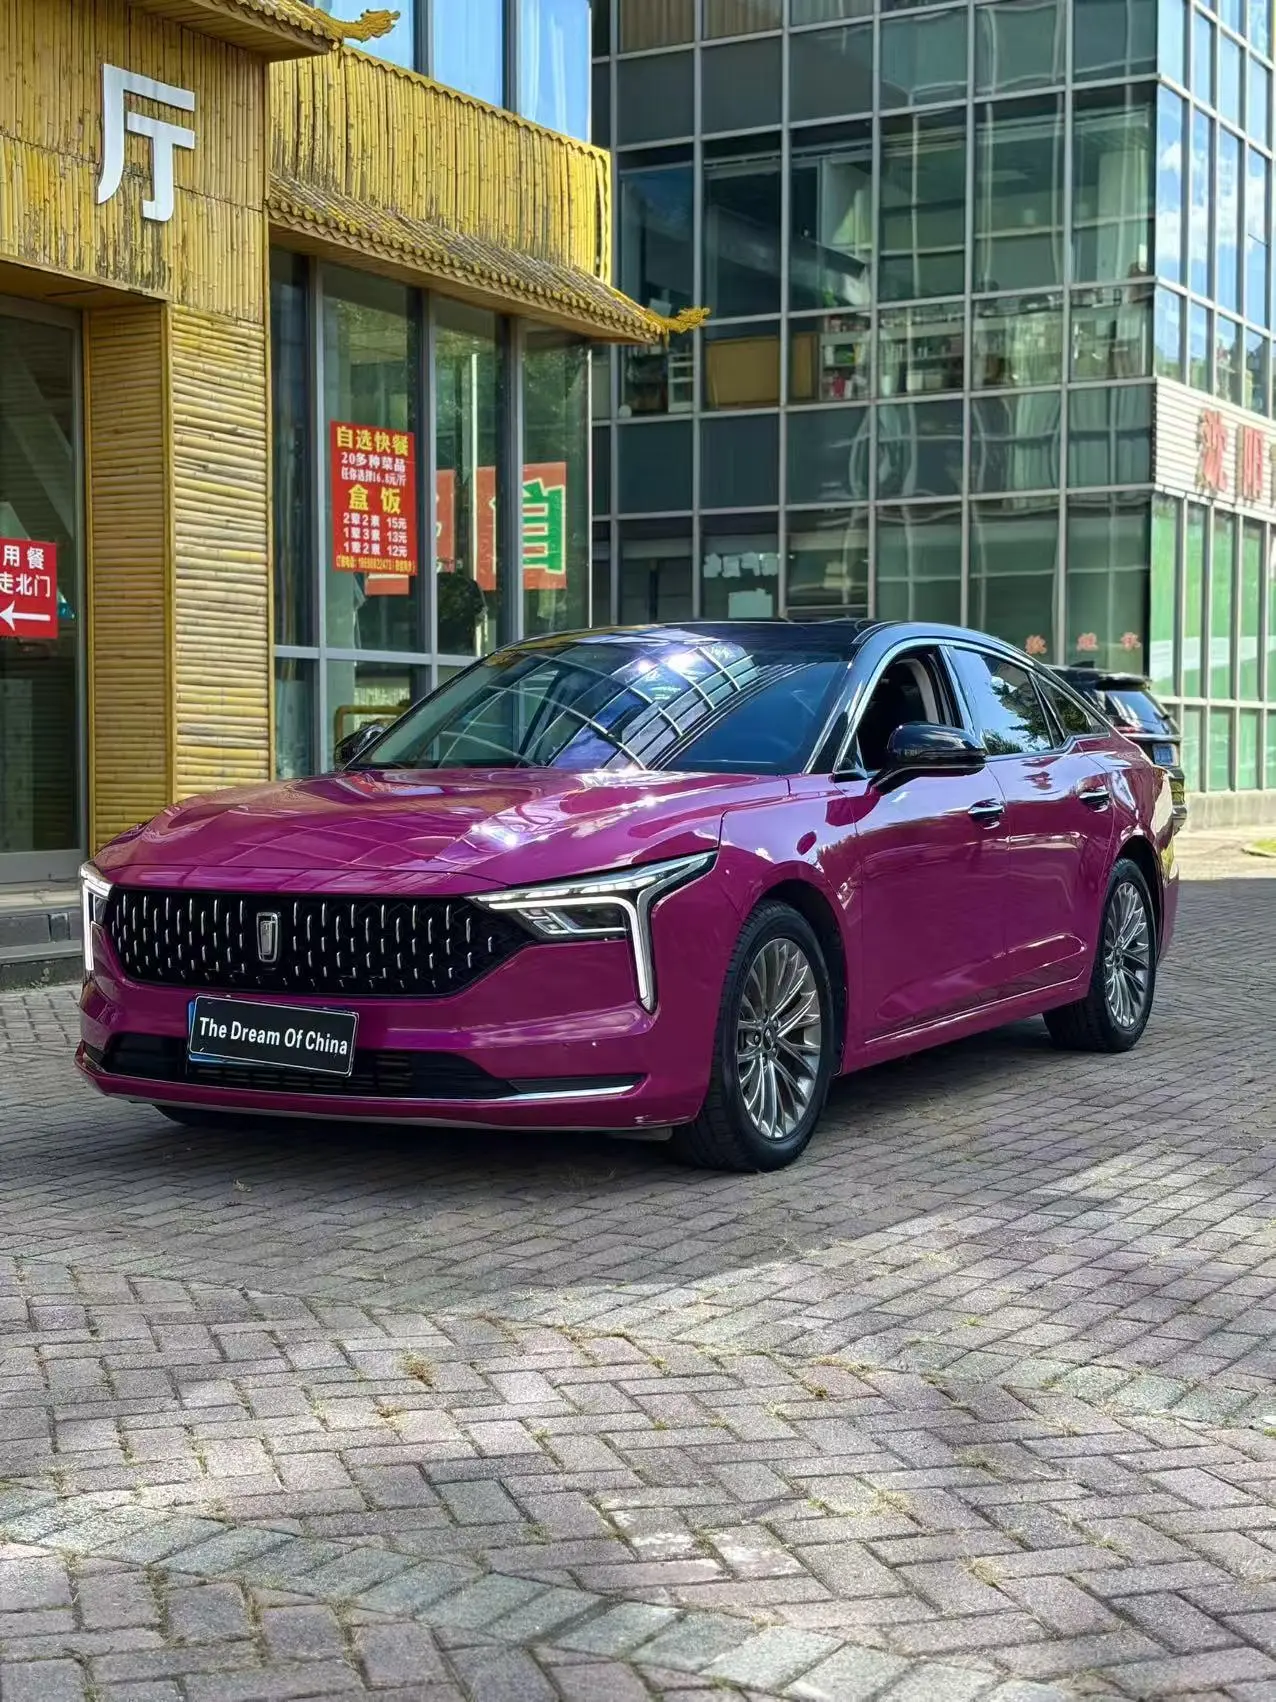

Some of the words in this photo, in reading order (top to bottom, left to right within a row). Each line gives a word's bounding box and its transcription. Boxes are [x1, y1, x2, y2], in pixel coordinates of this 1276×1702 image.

[97, 63, 195, 222] 厅
[336, 426, 409, 456] 自选快餐
[341, 451, 406, 473] 20多种菜品
[3, 545, 45, 570] 用餐
[0, 571, 51, 598] 走北门
[200, 1017, 228, 1039] The
[231, 1021, 281, 1046] Dream
[284, 1028, 303, 1049] Of
[305, 1031, 348, 1055] China
